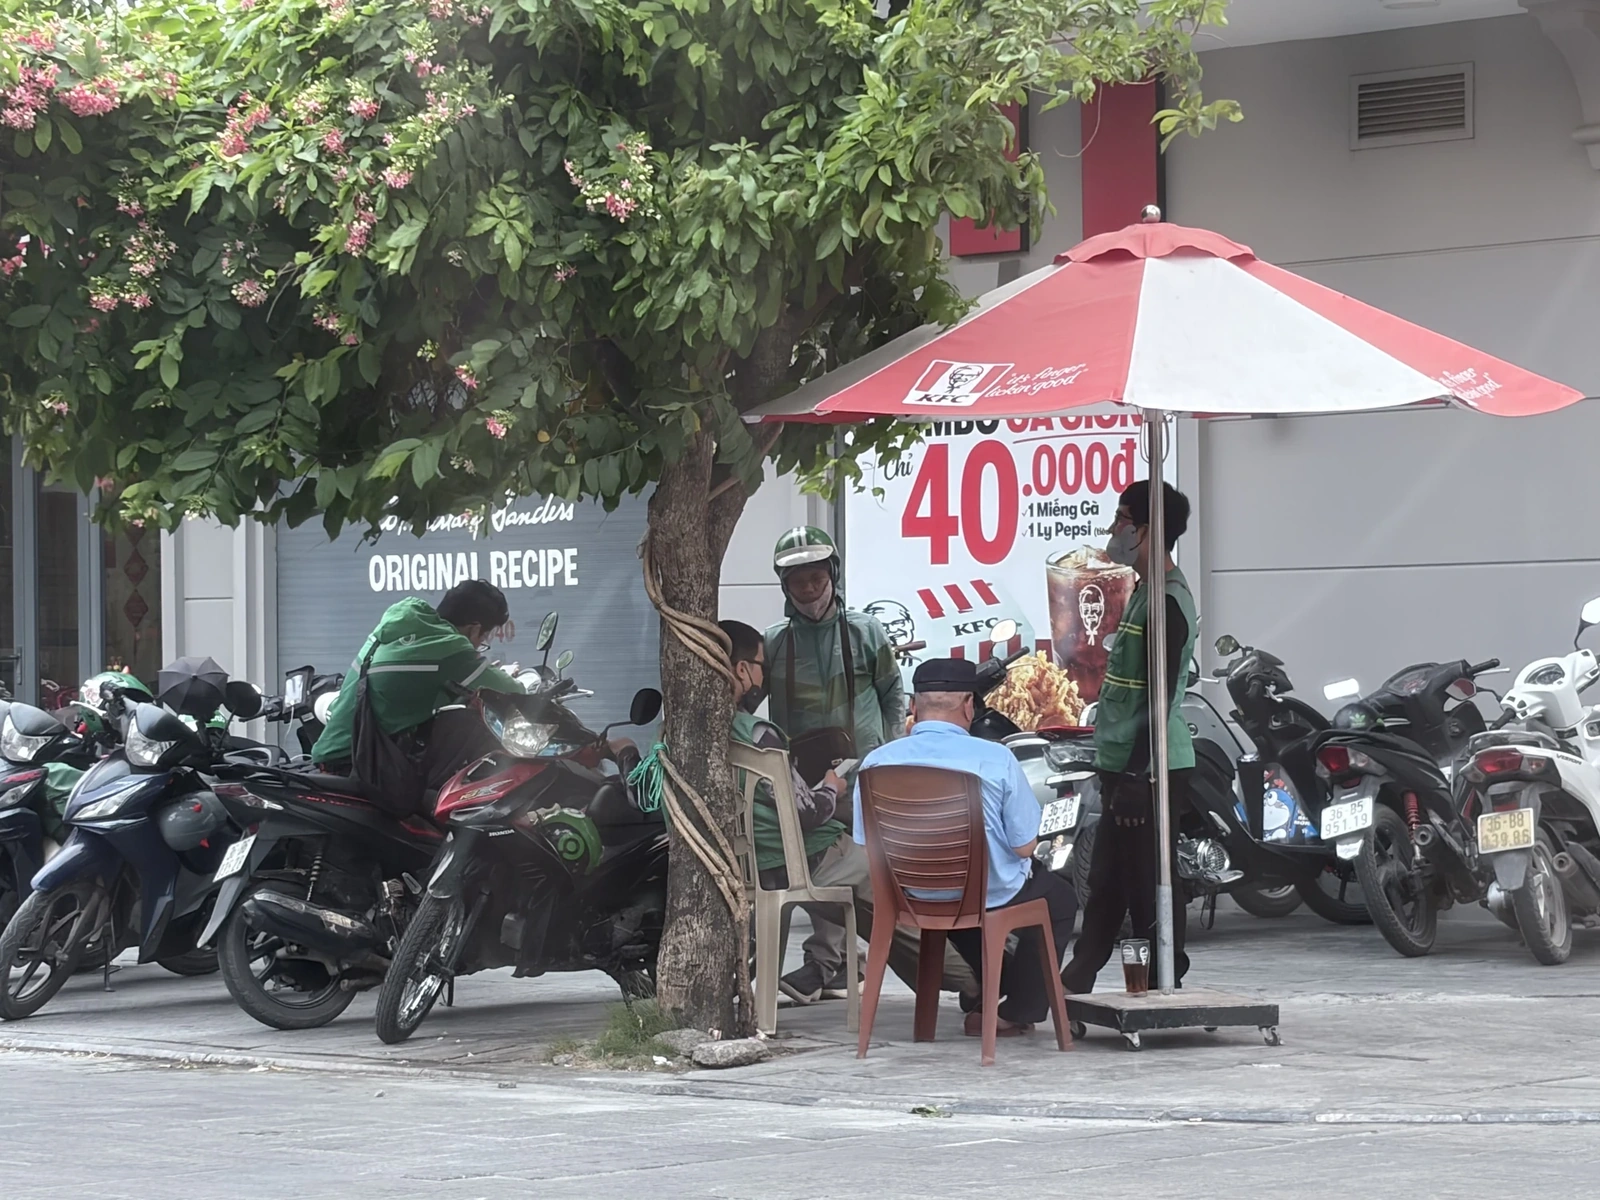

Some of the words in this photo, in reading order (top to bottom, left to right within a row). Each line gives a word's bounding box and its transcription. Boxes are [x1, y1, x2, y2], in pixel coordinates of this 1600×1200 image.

[915, 394, 970, 403] KFC
[1037, 498, 1077, 520] Miếng
[1080, 500, 1099, 516] Gà
[1037, 522, 1052, 541] Ly
[1055, 520, 1091, 540] Pepsi
[490, 548, 579, 588] RECIPE
[952, 617, 999, 636] KFC
[1329, 801, 1364, 821] 36-B5
[1325, 813, 1368, 836] 951.19
[1486, 811, 1524, 833] 36-B8
